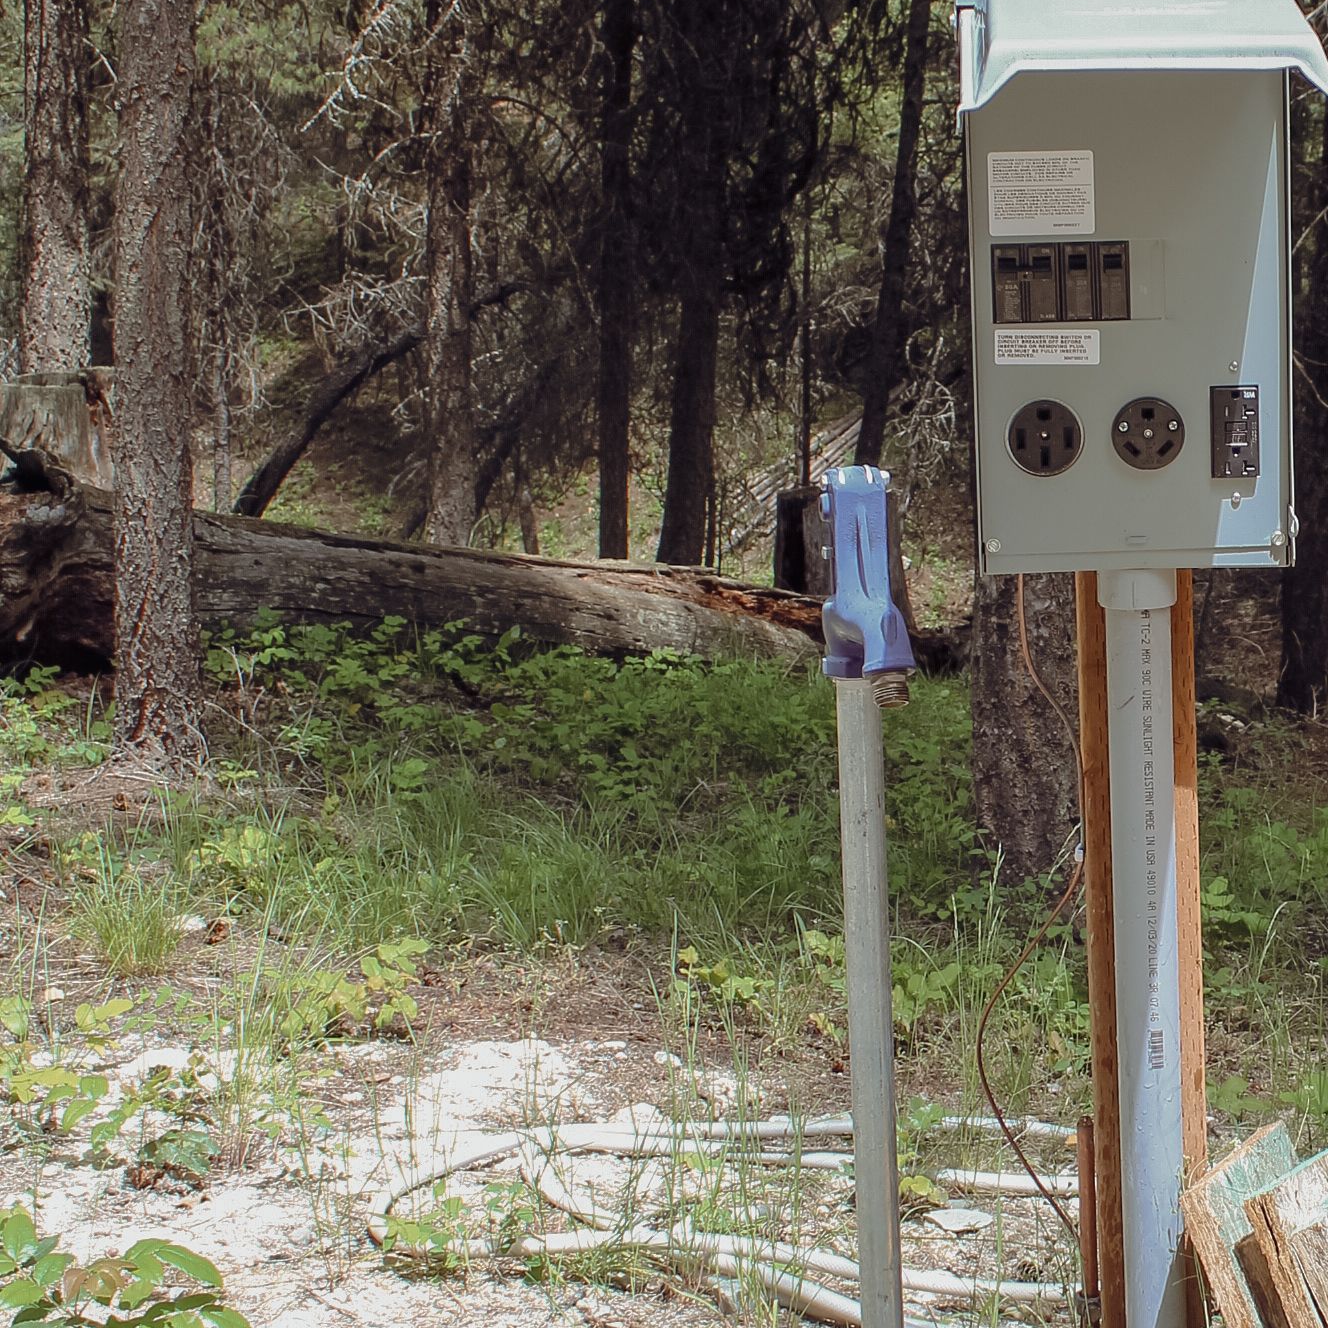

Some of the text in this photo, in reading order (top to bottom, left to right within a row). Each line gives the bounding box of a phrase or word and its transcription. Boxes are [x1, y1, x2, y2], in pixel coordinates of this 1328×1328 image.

[1141, 623, 1150, 645] TC-2
[1142, 648, 1151, 665] MAX
[1142, 670, 1151, 686] 90C
[1142, 715, 1153, 756] SUNLIGHT
[1144, 760, 1154, 806] RESISTANT
[1145, 809, 1155, 830] MADE
[1146, 835, 1155, 846] IN
[1146, 849, 1156, 865] USA
[1147, 870, 1157, 895] 49010
[1147, 915, 1157, 954] 12/03/20
[1148, 957, 1158, 978] LINE
